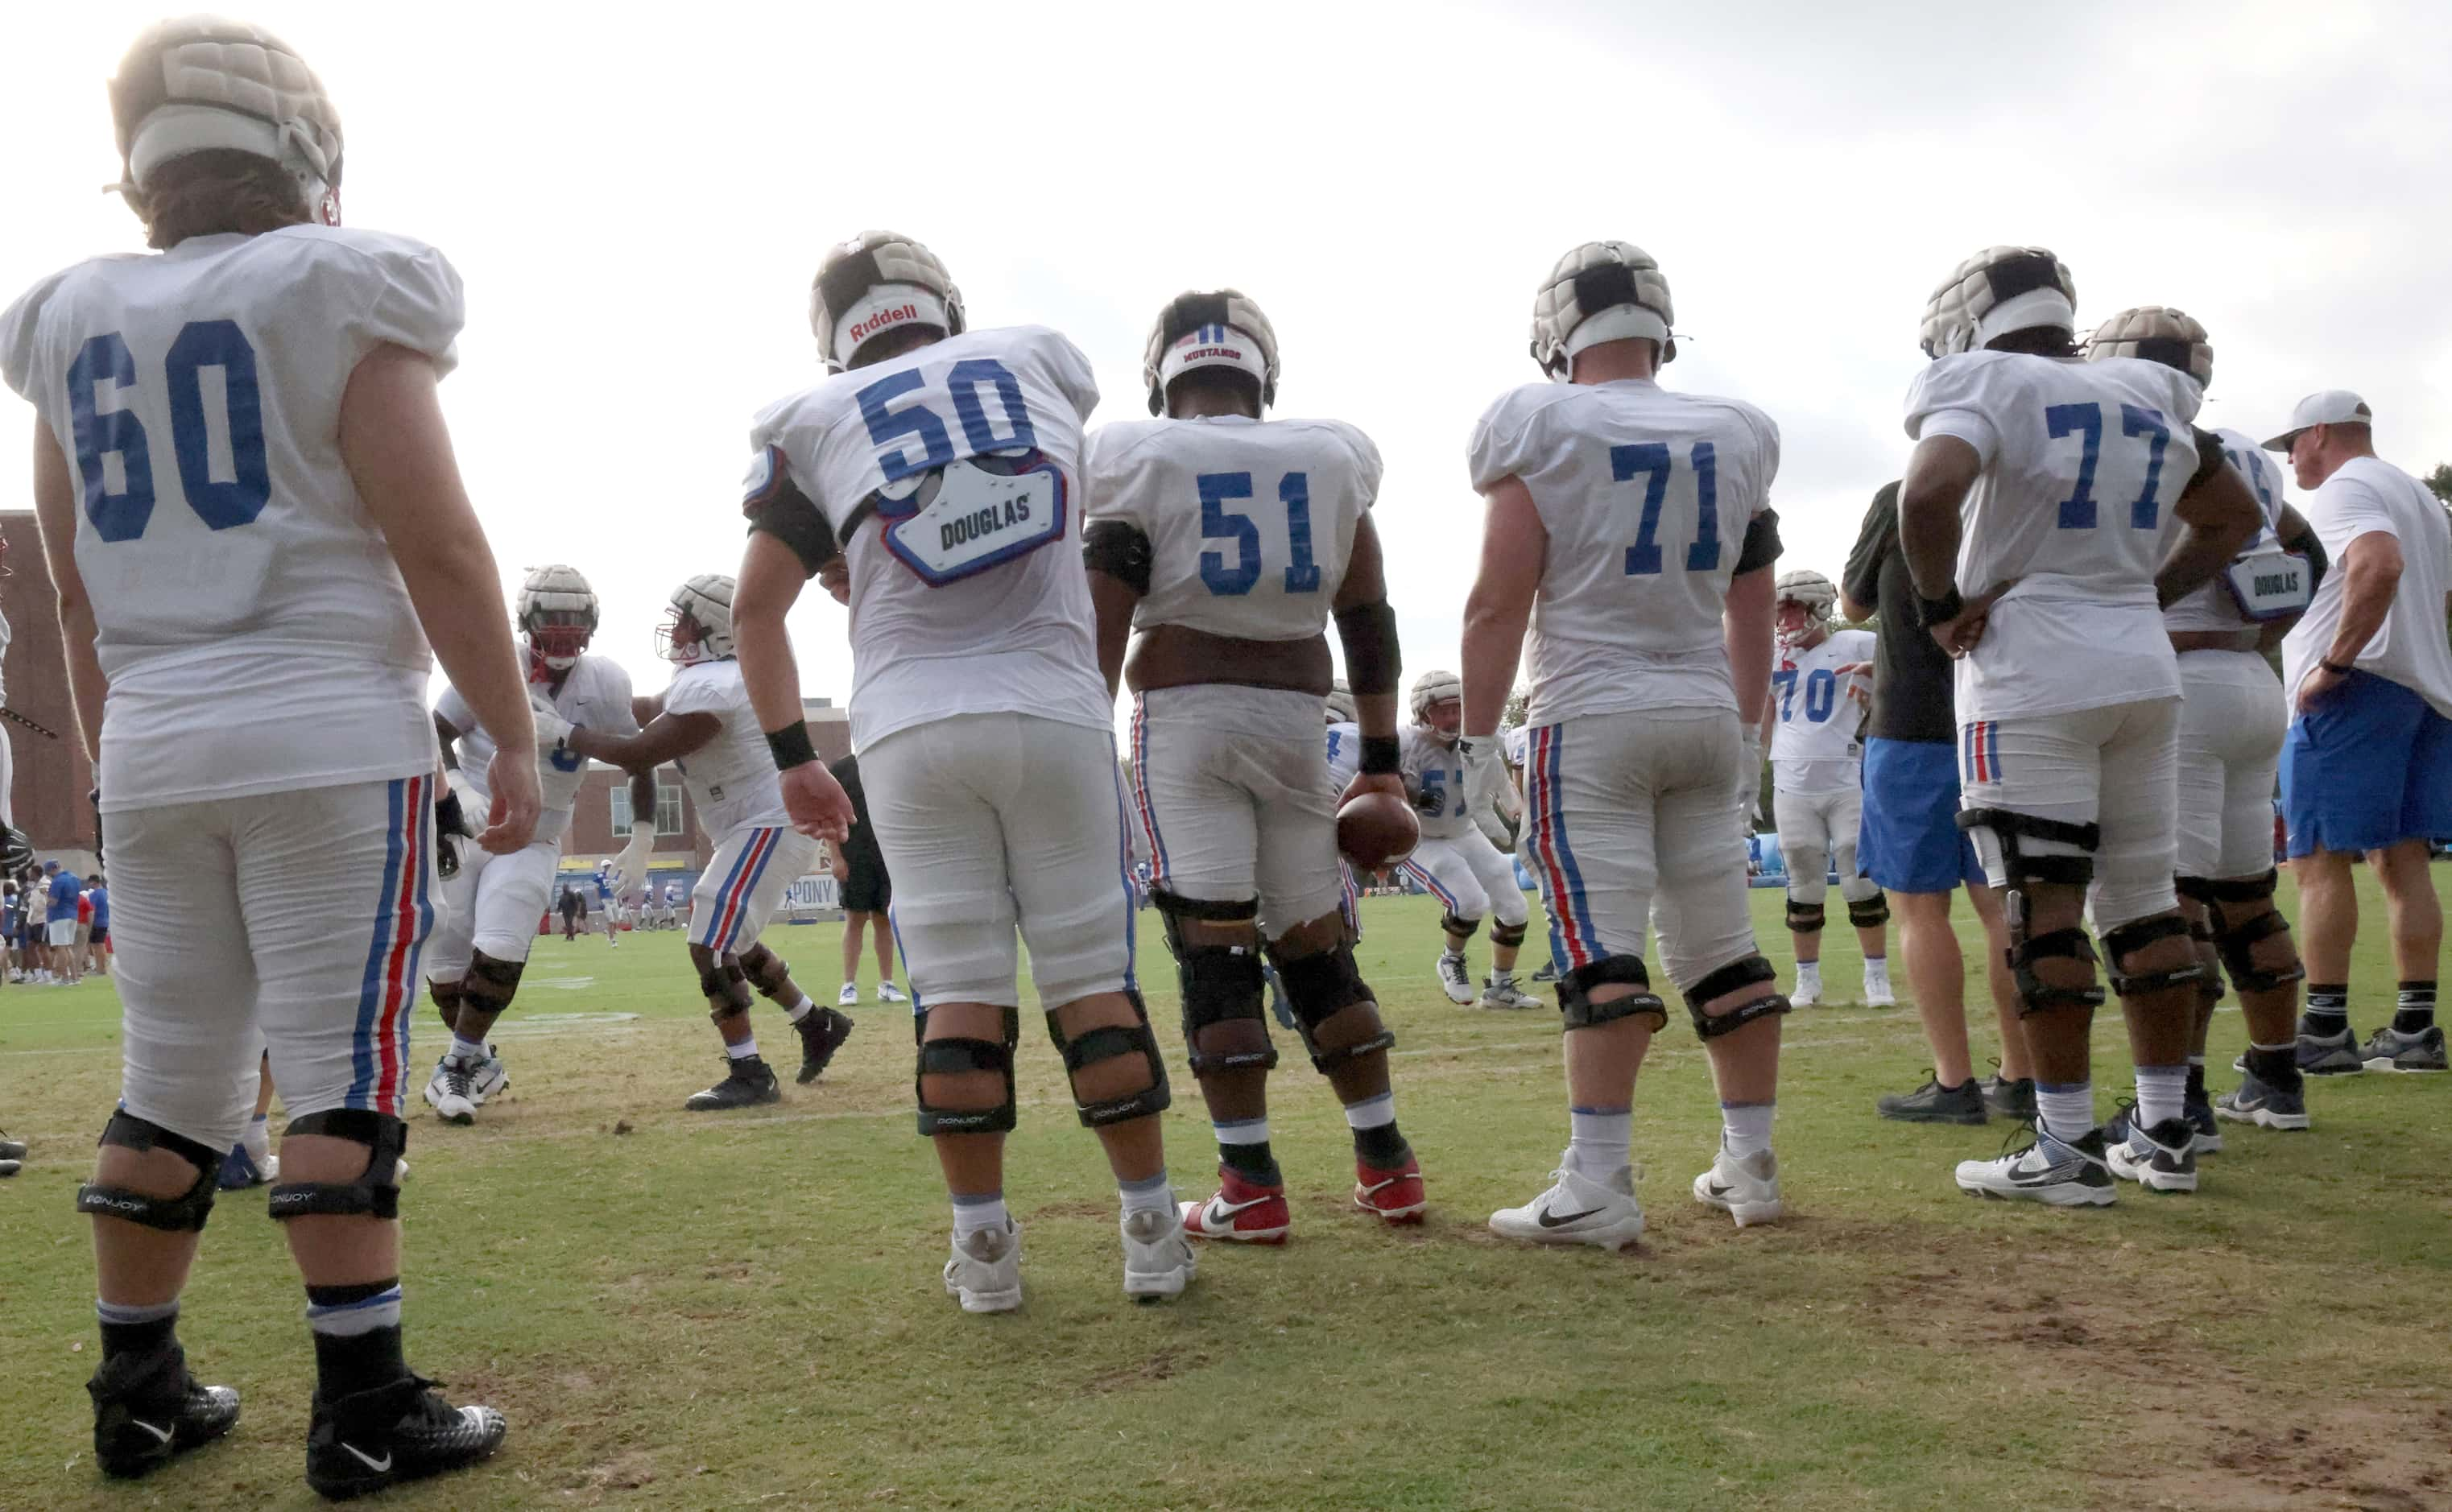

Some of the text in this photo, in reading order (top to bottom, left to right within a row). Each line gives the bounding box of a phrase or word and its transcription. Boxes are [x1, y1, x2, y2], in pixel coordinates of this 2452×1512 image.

[850, 304, 917, 342] Riddell
[1185, 347, 1241, 363] MUSTANGS
[67, 319, 271, 543] 60
[855, 359, 1037, 483] 50
[2045, 402, 2171, 529] 77
[941, 494, 1031, 552] DOUGLAS
[1197, 471, 1321, 597] 51
[1610, 441, 1722, 576] 71
[2255, 572, 2299, 597] DOUGLAS
[1772, 668, 1837, 723] 70
[793, 880, 832, 903] PONY
[937, 1116, 986, 1125] DONJOY
[85, 1195, 143, 1212] DONJOY
